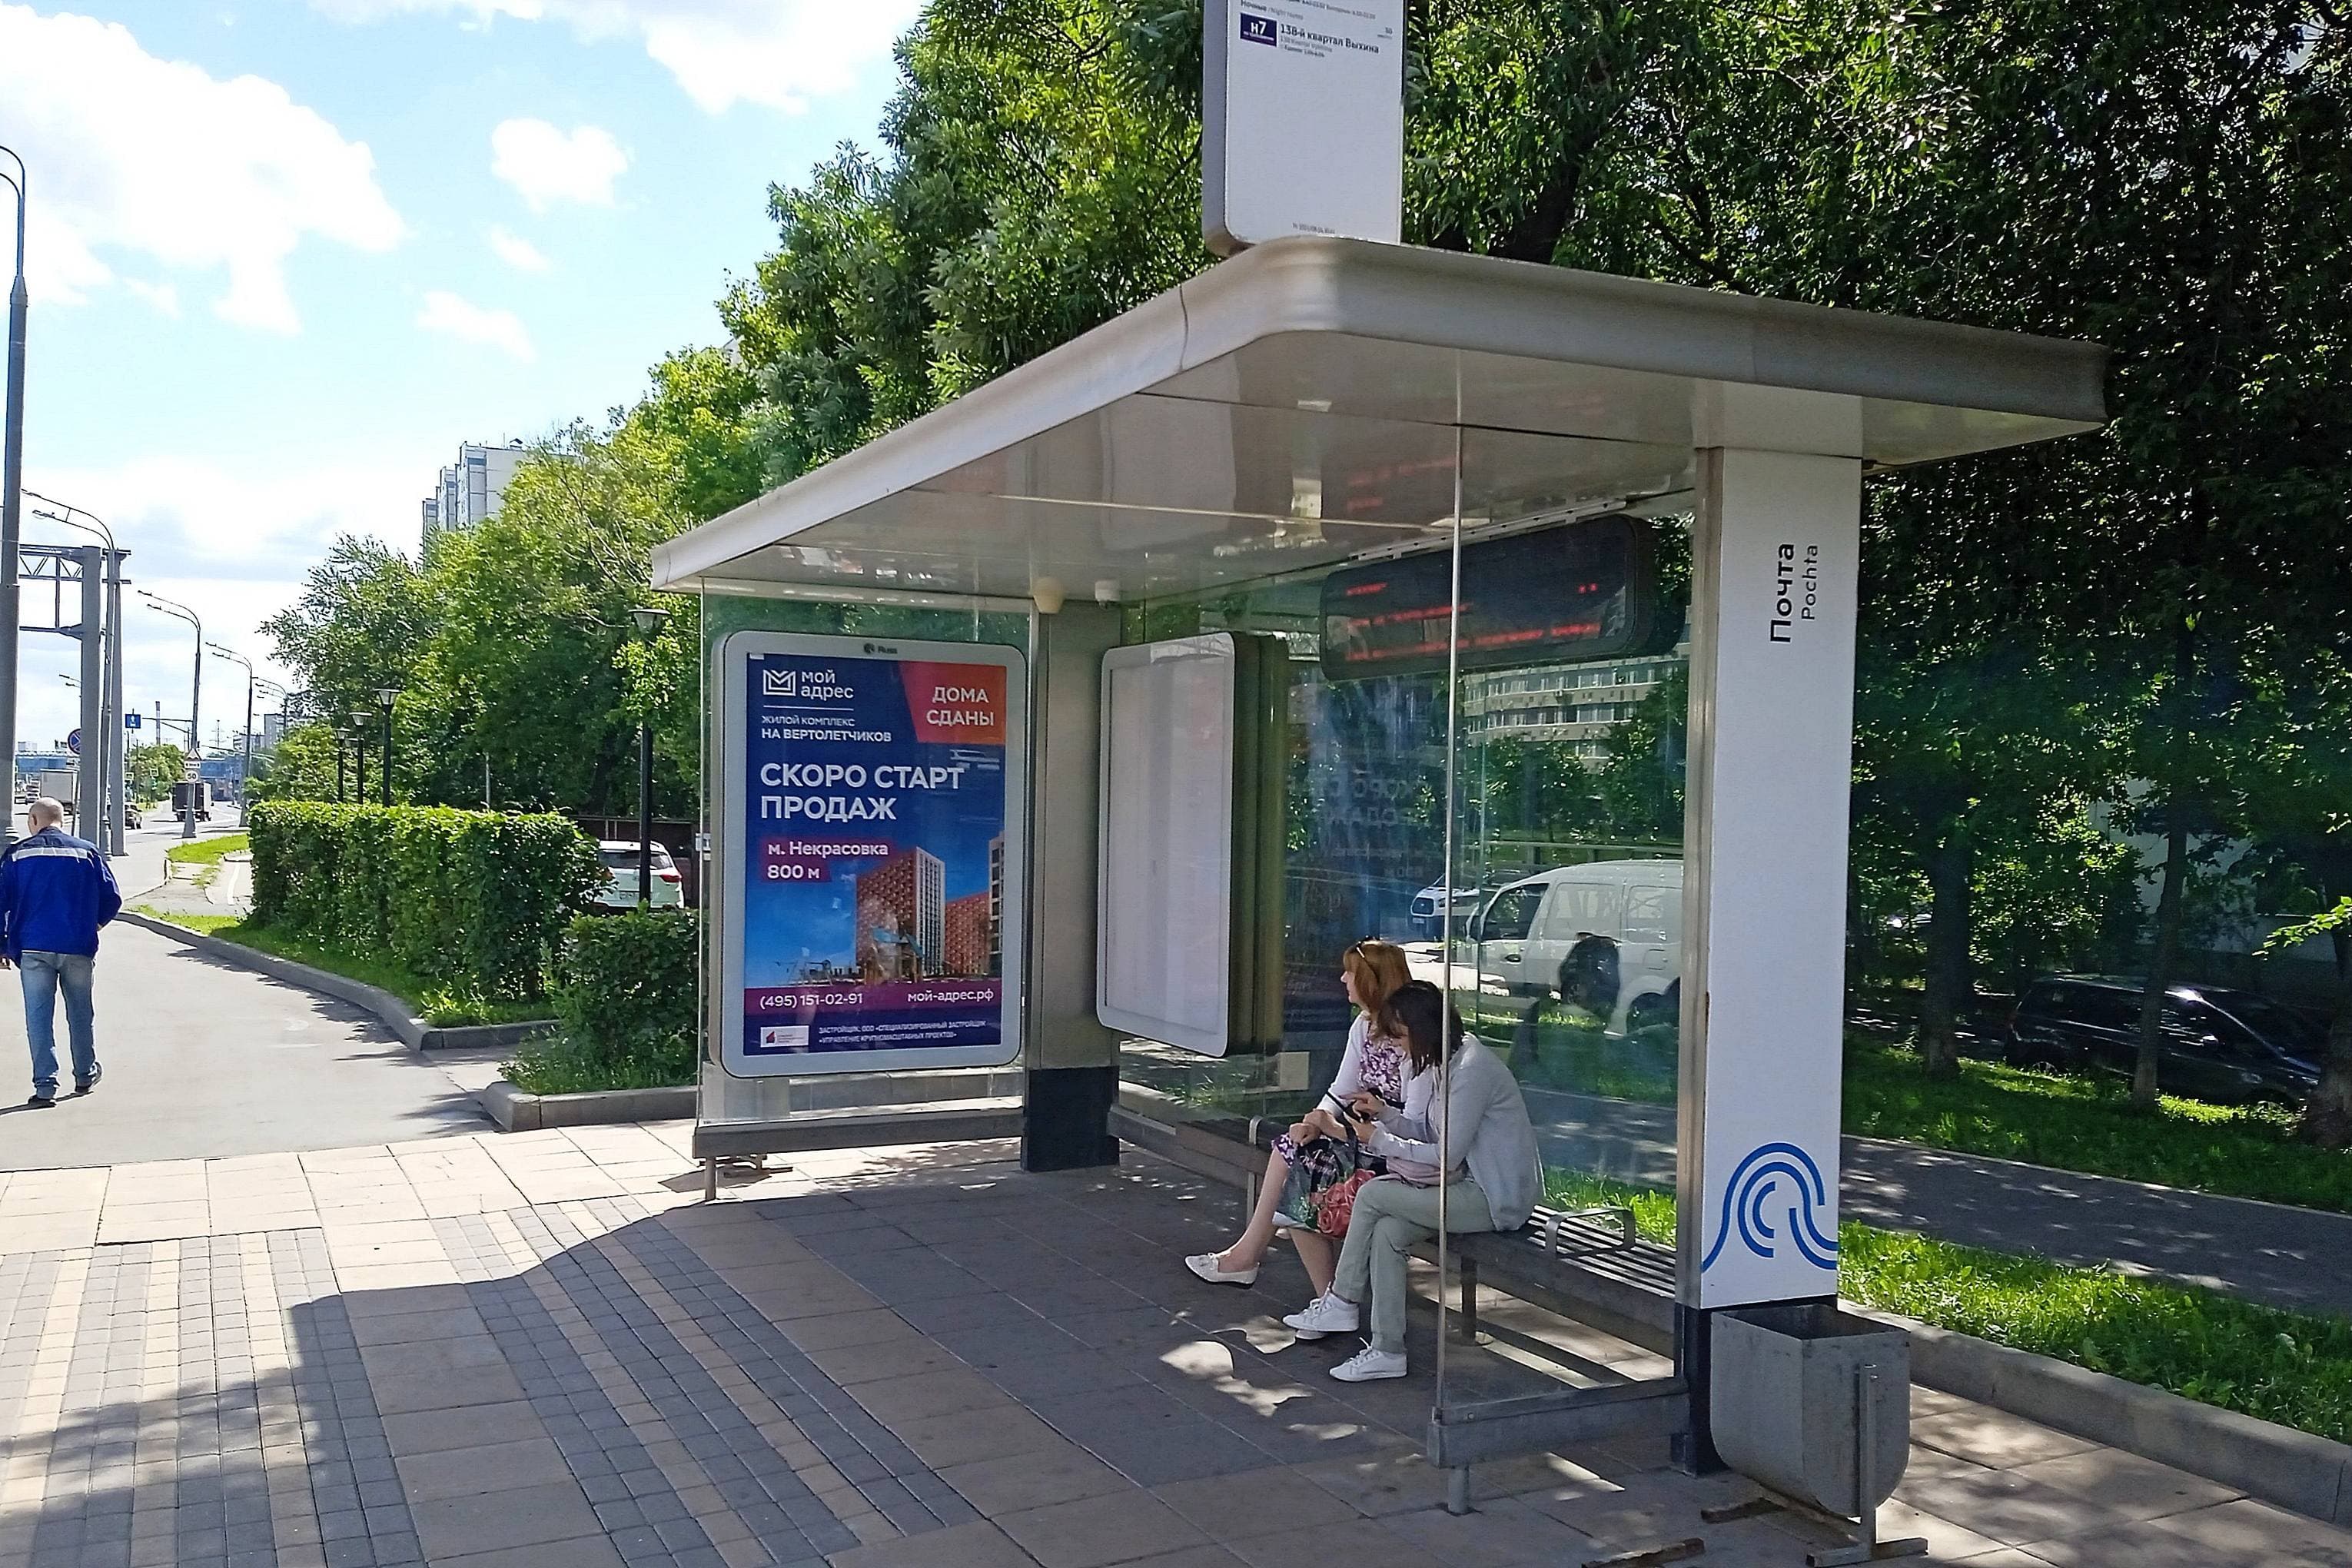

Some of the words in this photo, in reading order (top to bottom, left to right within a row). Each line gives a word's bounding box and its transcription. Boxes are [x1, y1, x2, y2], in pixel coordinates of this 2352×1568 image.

[1281, 24, 1305, 38] 138-й
[1307, 32, 1344, 47] квартал
[1345, 37, 1379, 54] Выхина
[1802, 545, 1818, 620] Pochta
[1770, 543, 1794, 643] Почта
[801, 669, 835, 683] мой
[801, 685, 854, 701] адрес
[932, 686, 989, 704] ДОМА
[762, 715, 799, 725] ЖИЛОЙ
[801, 716, 855, 726] КОМПЛЕКС
[926, 709, 994, 726] СДАНЫ
[762, 729, 781, 739] НА
[783, 729, 892, 742] ВЕРТОЛЕТЧИКОВ
[760, 762, 867, 788] СКОРО
[874, 766, 965, 790] СТАРТ
[761, 796, 897, 822] ПРОДАЖ
[768, 844, 786, 855] м.
[789, 841, 889, 859] Некрасовка
[768, 865, 804, 879] 800
[807, 868, 820, 879] м
[759, 995, 797, 1010] (495)
[800, 992, 863, 1006] 151-02-91
[907, 988, 995, 1003] мой-адрес.рф
